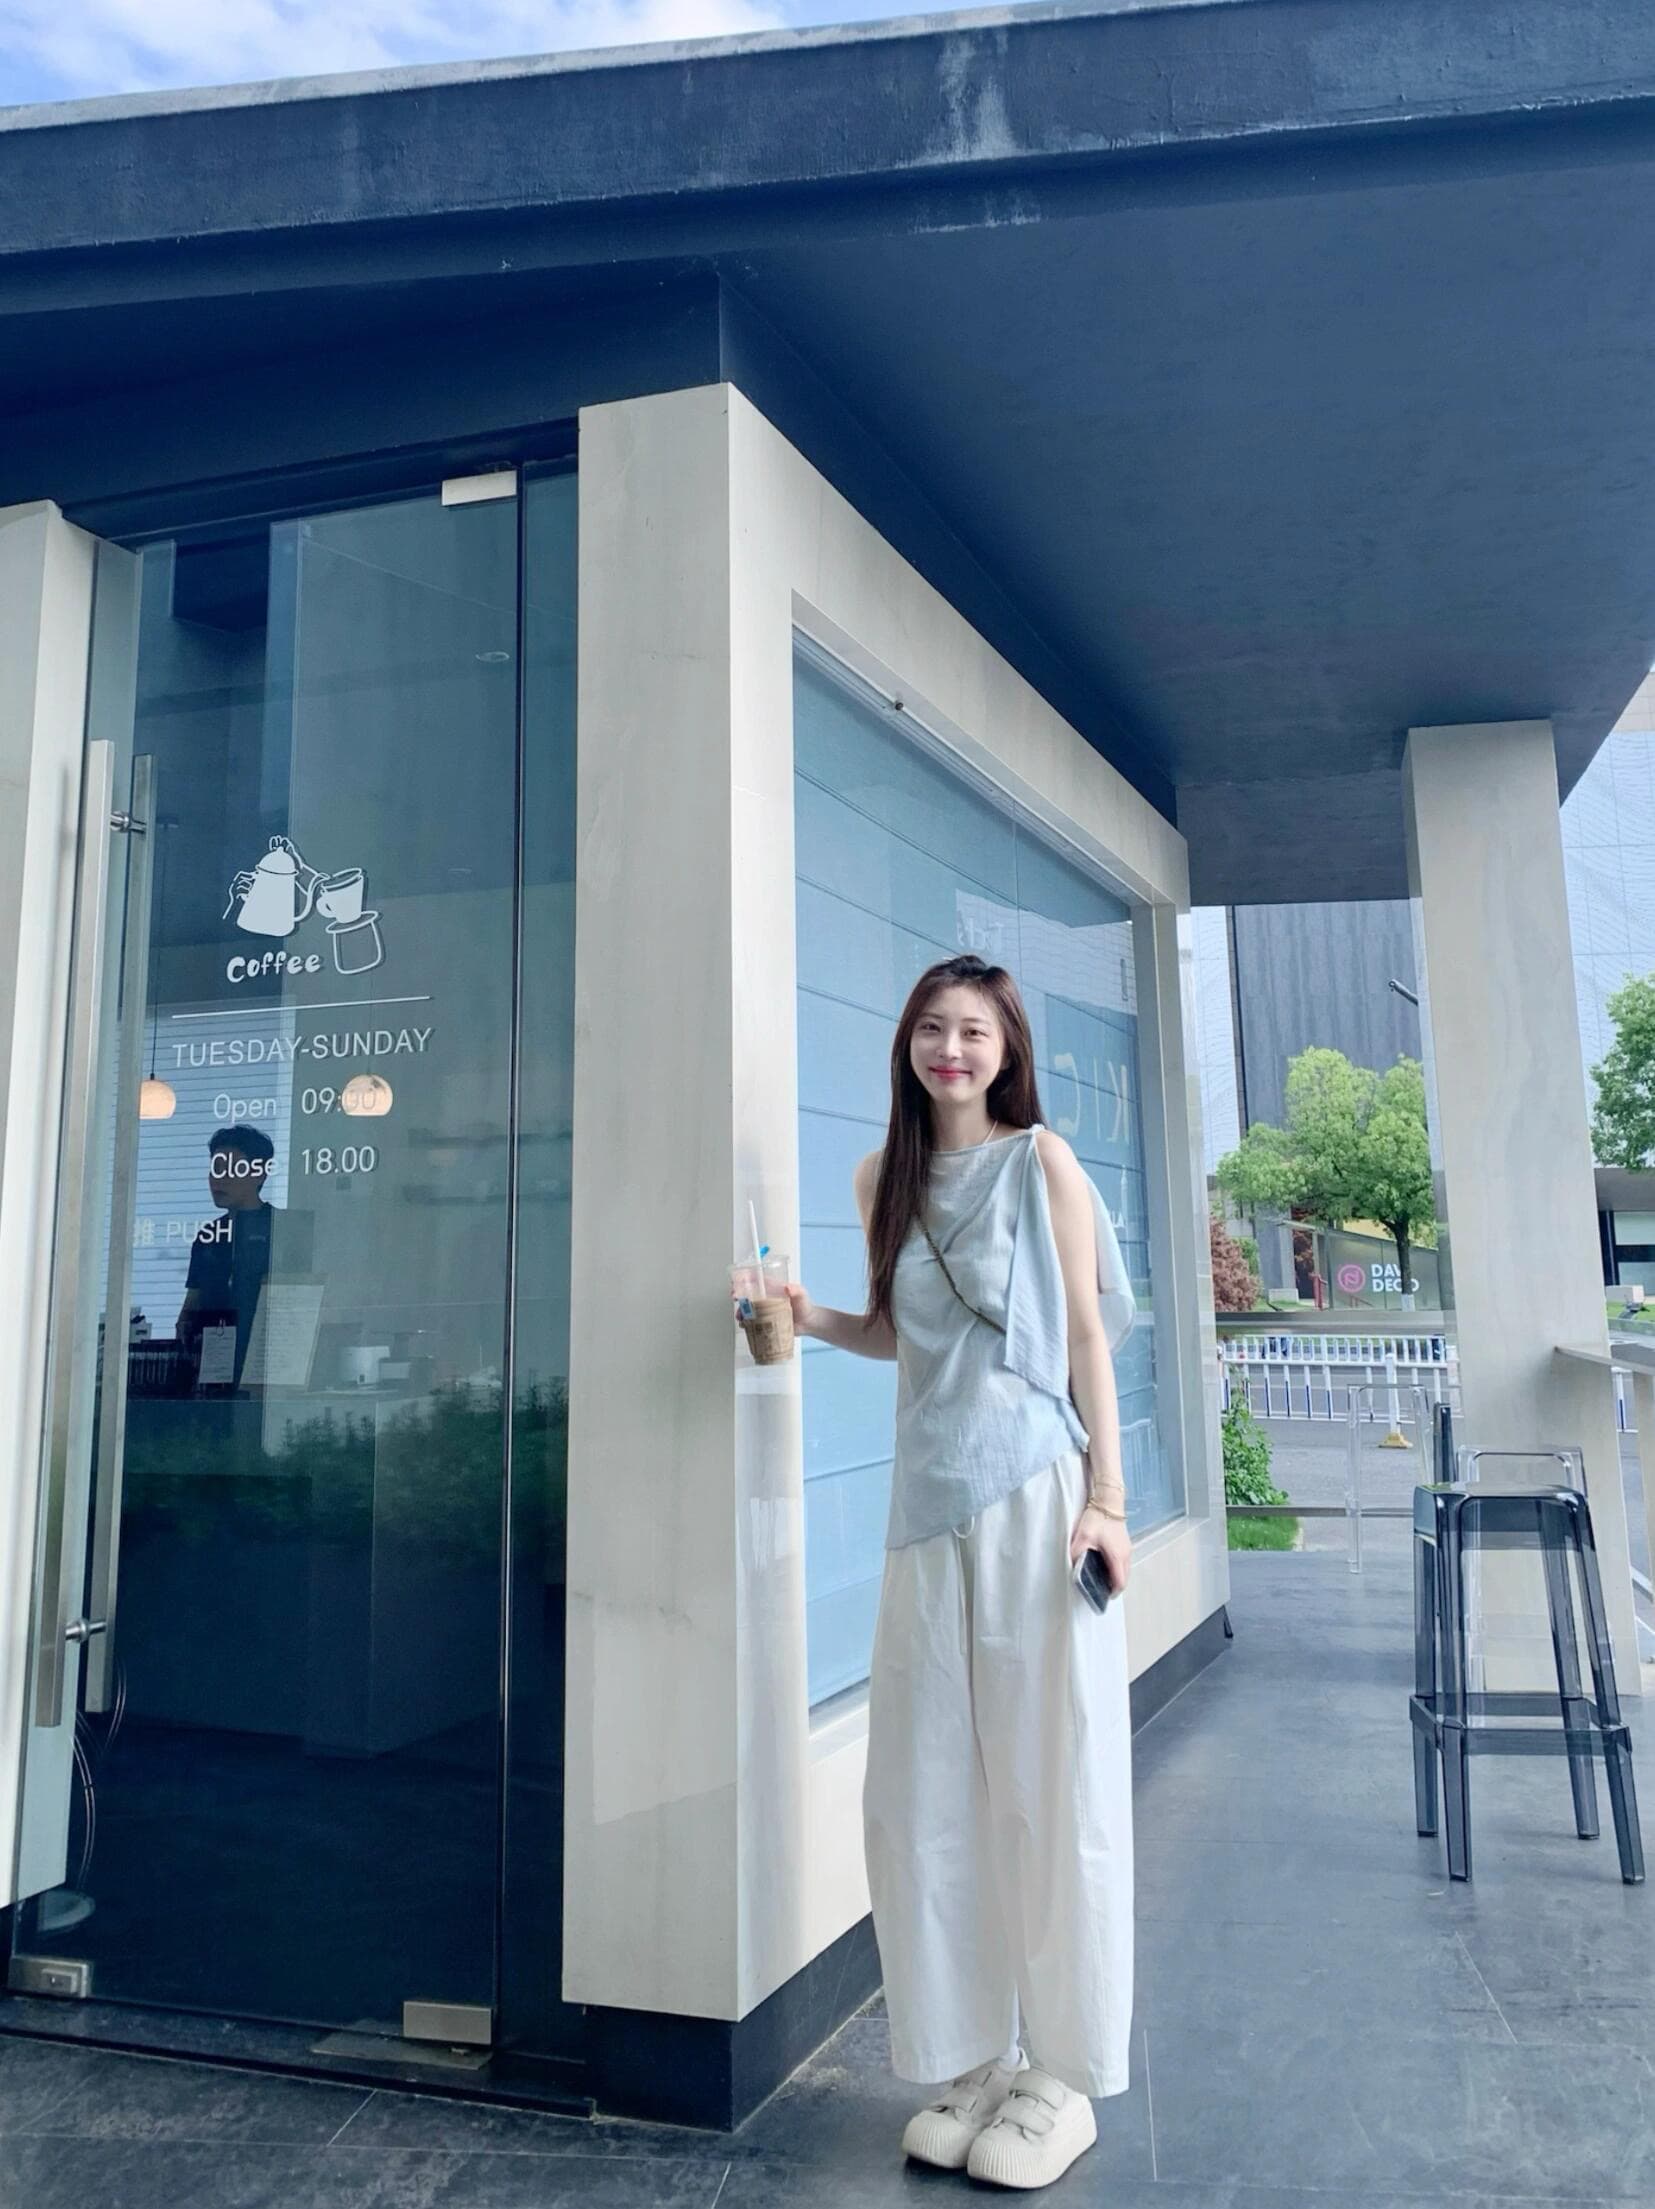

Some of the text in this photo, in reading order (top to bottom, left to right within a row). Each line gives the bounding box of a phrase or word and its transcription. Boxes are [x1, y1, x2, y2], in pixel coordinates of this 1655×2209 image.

[227, 951, 320, 983] Coffee
[173, 1028, 431, 1067] TUESDAY-SUNDAY
[214, 1086, 375, 1124] Open 09:00
[210, 1146, 375, 1179] Close 18.00
[166, 1219, 233, 1244] PUSH
